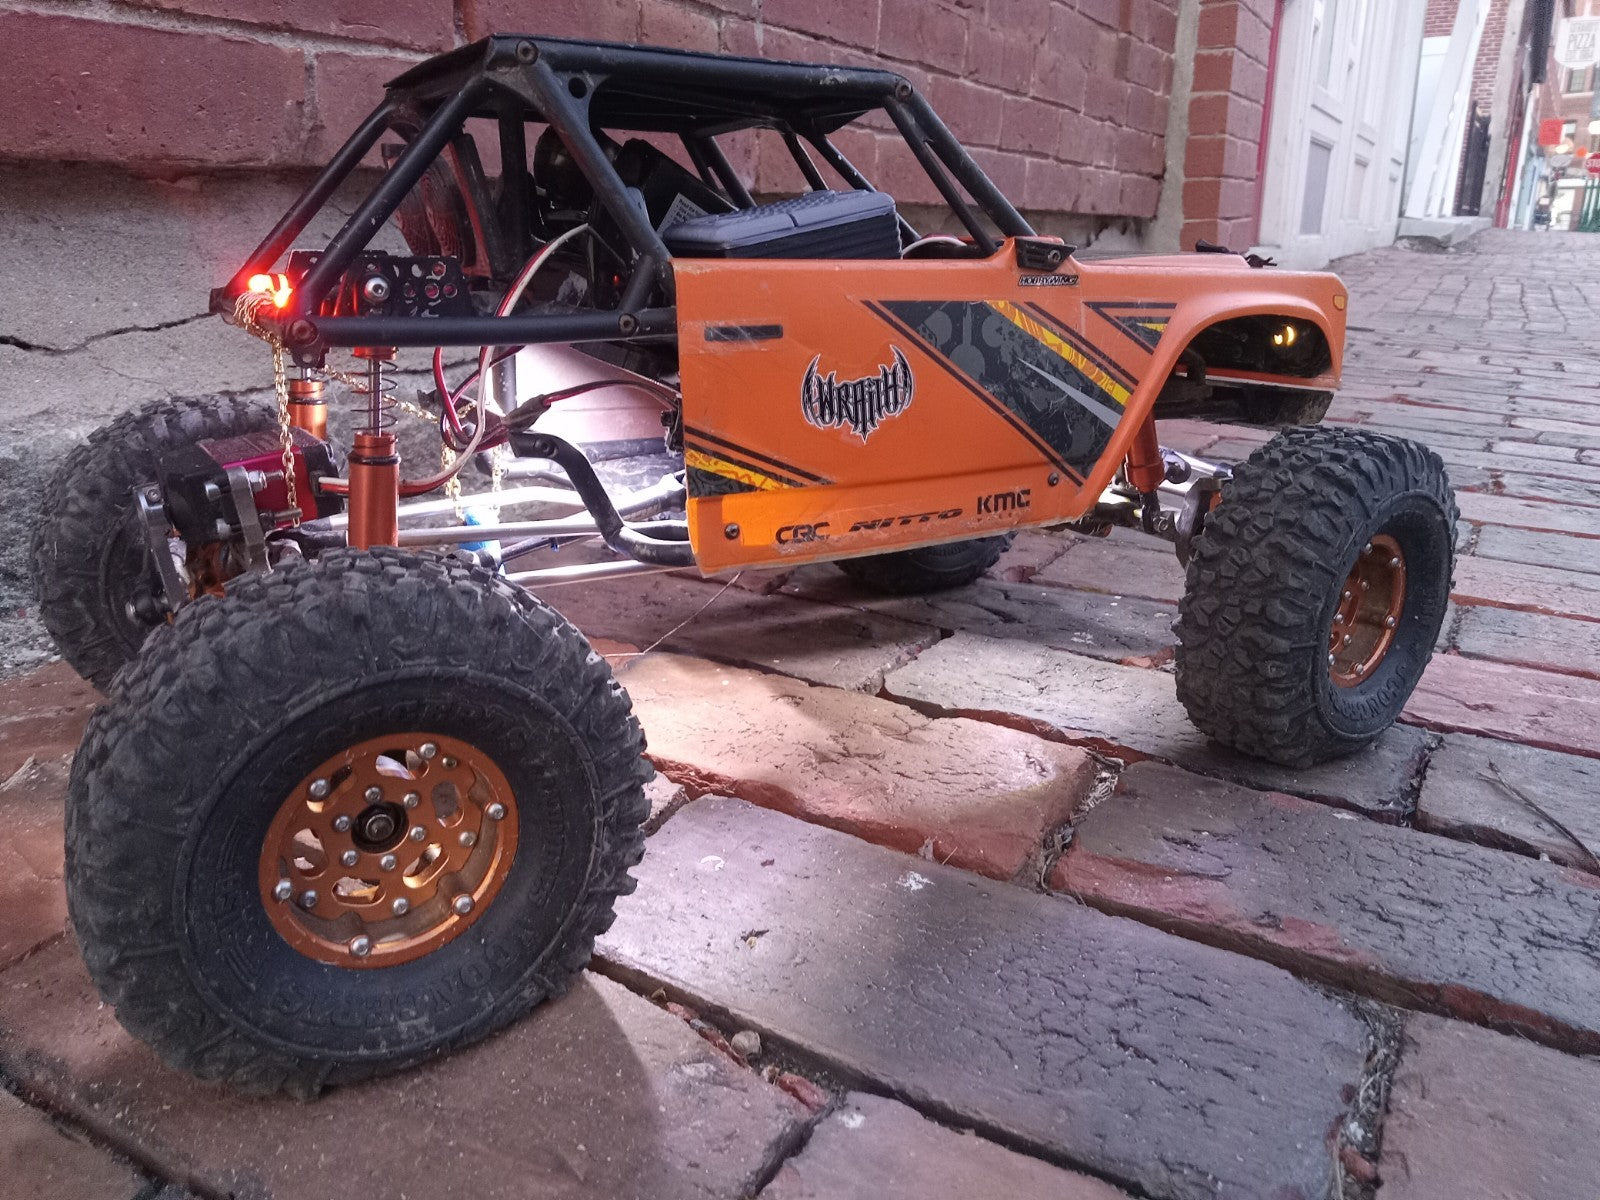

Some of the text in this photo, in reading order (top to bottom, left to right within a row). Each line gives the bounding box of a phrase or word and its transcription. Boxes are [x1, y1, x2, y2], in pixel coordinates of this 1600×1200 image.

[1567, 33, 1596, 50] PIZZA
[801, 344, 914, 444] WRAITH
[849, 508, 963, 532] NITTO
[976, 489, 1031, 514] KMC
